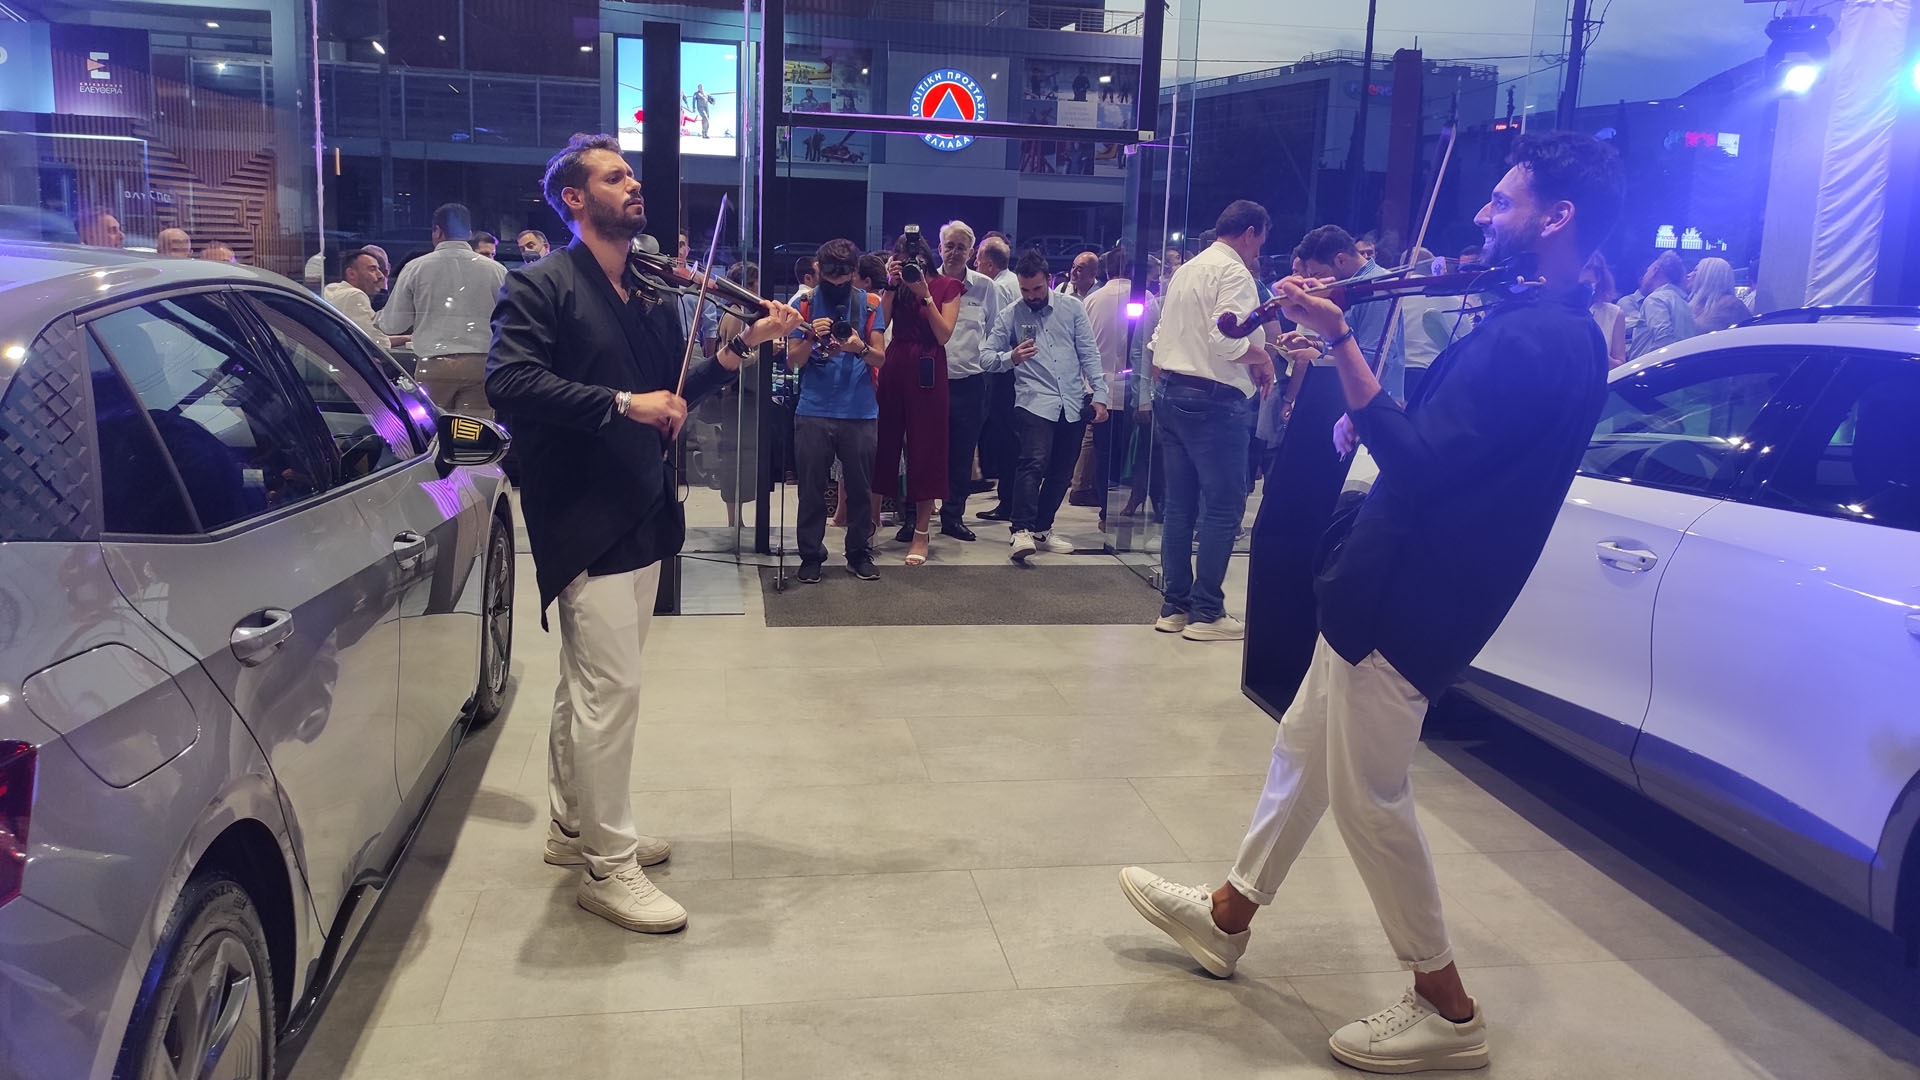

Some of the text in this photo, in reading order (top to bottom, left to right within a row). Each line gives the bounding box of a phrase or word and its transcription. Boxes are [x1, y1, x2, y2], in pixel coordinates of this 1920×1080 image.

[80, 85, 123, 94] ΕΛΕΥΘΕΡΙΑ
[947, 72, 985, 121] ΠΡΟΣΤΑΣΙΑ
[925, 134, 970, 148] ΕΛΛΑΔΑ
